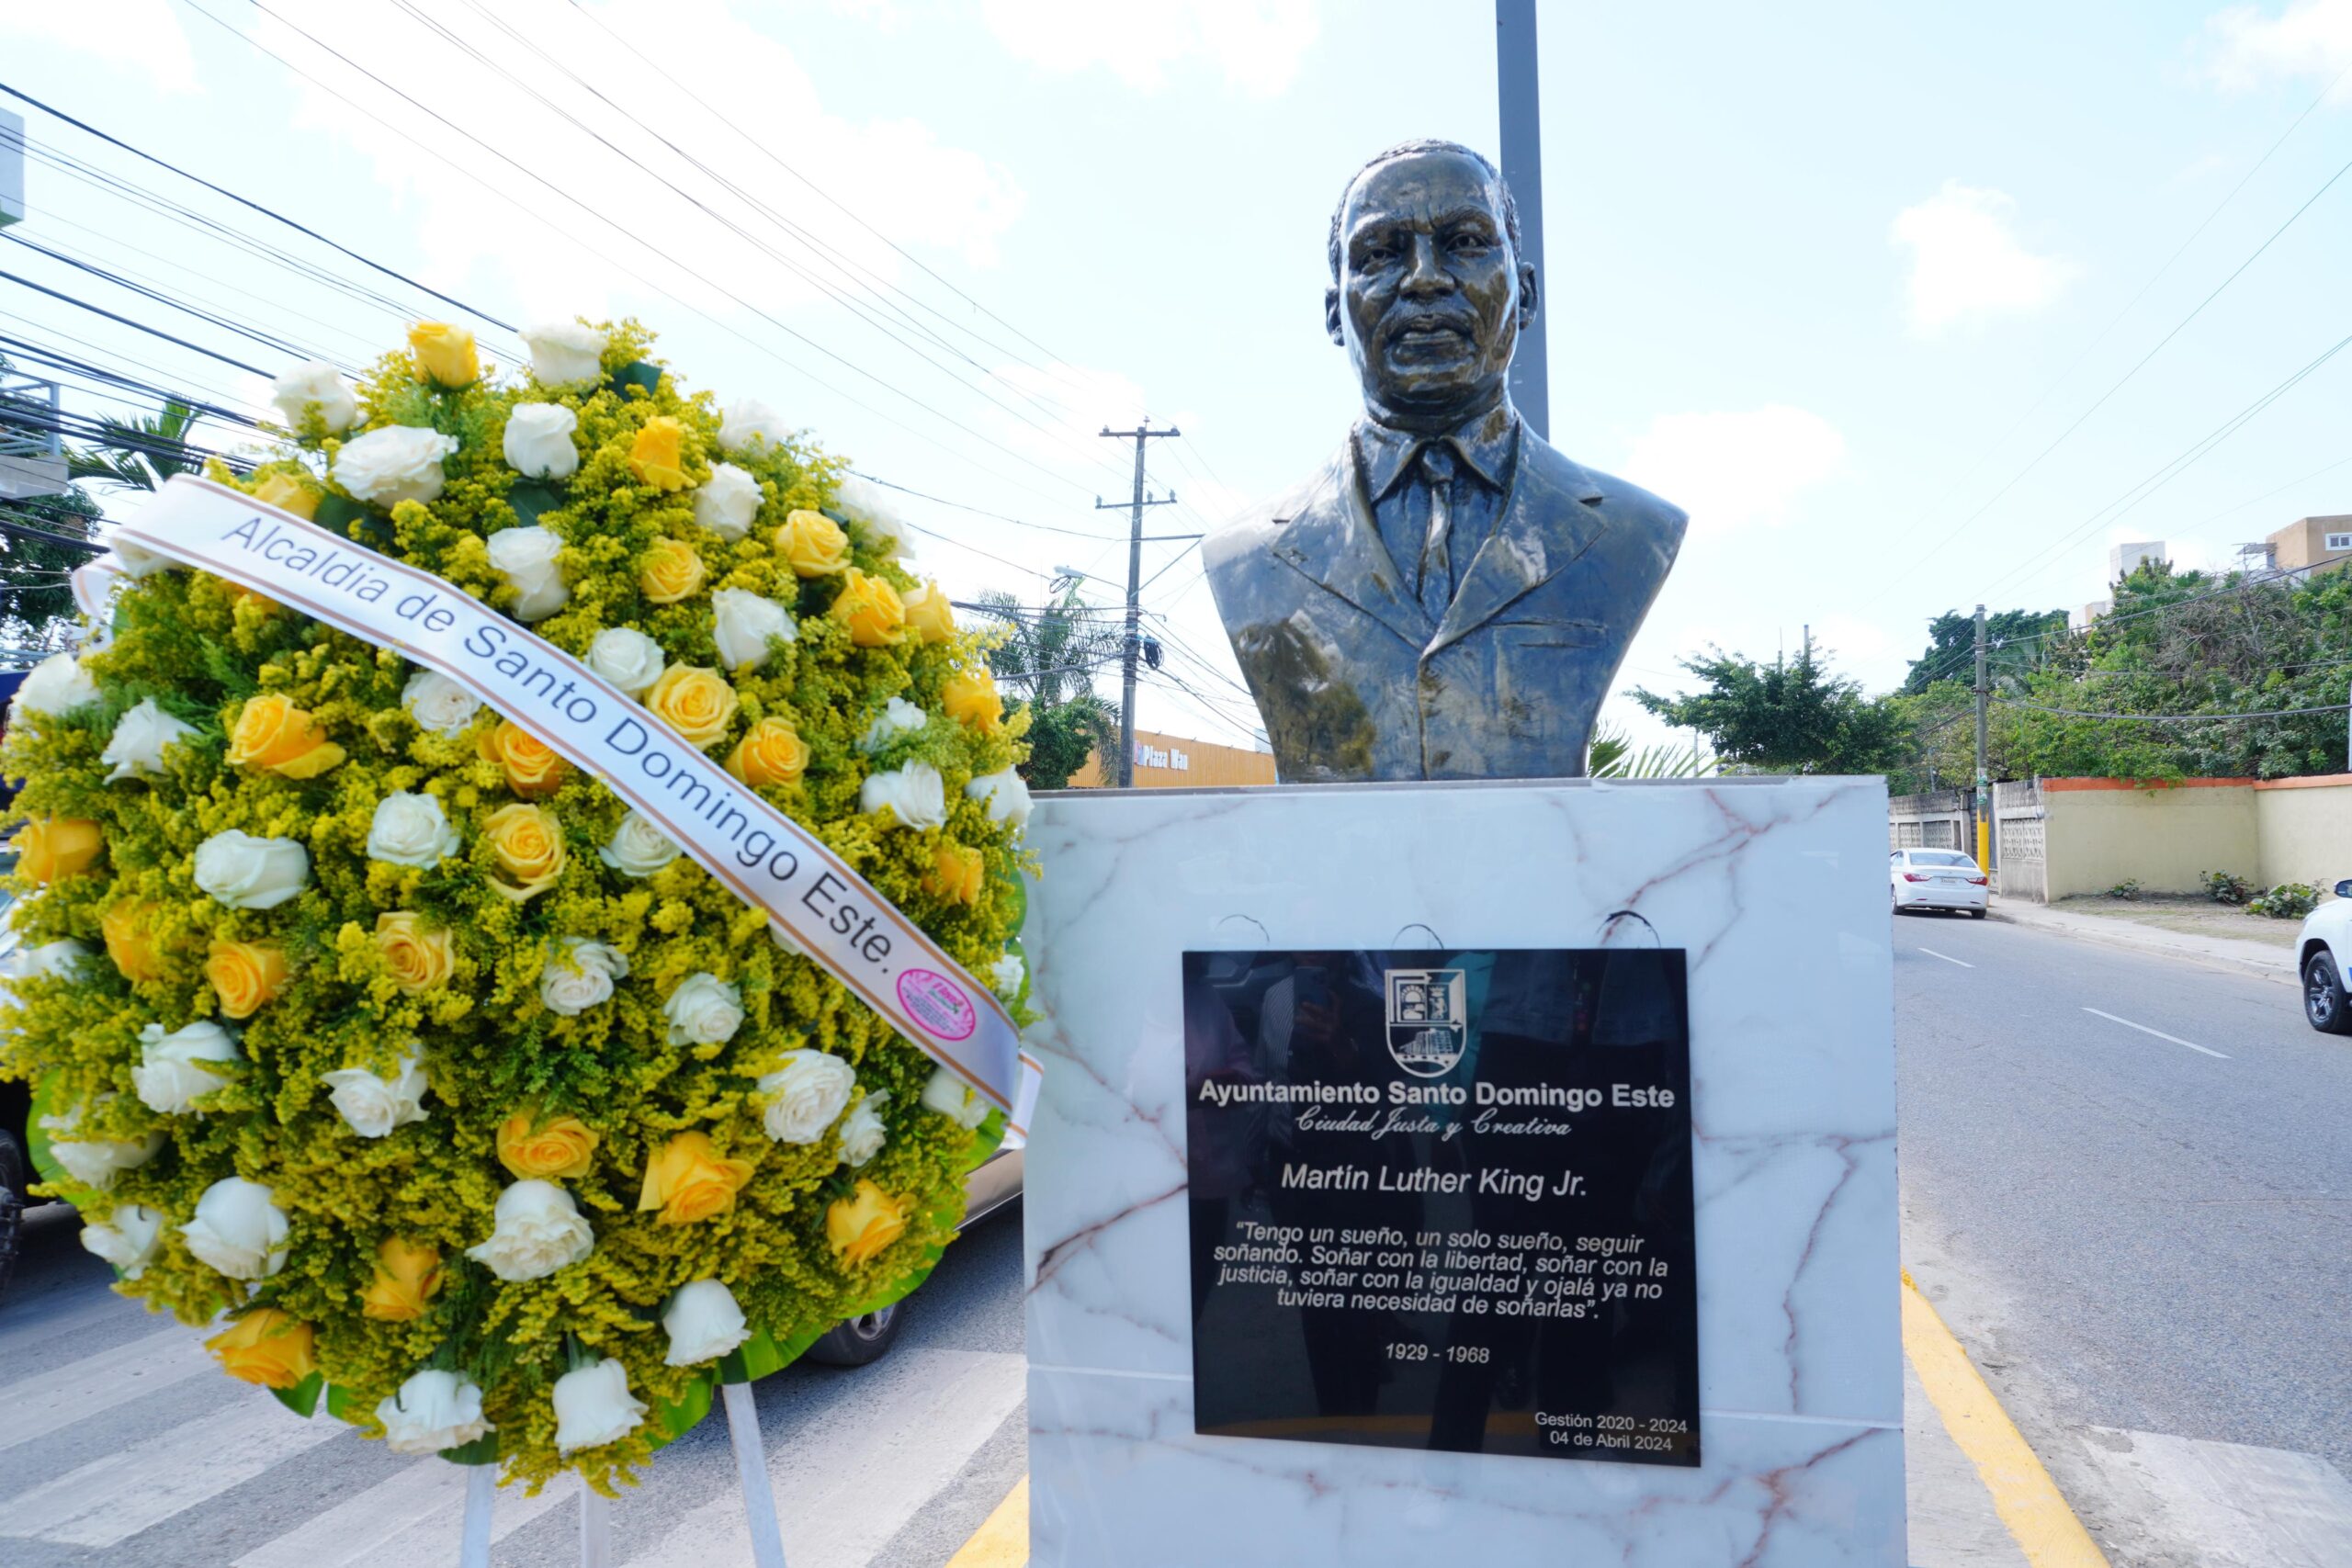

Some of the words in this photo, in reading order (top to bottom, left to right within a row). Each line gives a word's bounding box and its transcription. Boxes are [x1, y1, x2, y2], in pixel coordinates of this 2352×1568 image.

[1143, 745, 1168, 768] Plaza
[397, 593, 456, 632] de
[464, 626, 597, 724] Santo
[604, 717, 799, 882] Domingo
[801, 872, 892, 974] Este.
[1198, 1078, 1380, 1107] Ayuntamiento
[1387, 1080, 1467, 1105] Santo
[1476, 1082, 1603, 1113] Domingo
[1611, 1083, 1675, 1108] Este
[1295, 1105, 1380, 1132] Ciudad
[1371, 1106, 1439, 1140] Justa
[1440, 1122, 1463, 1141] y
[1471, 1108, 1572, 1135] Creativa
[1281, 1163, 1369, 1190] Martín
[1378, 1165, 1472, 1193] Luther
[1478, 1168, 1544, 1202] King
[1553, 1170, 1586, 1196] Jr.
[1309, 1228, 1334, 1243] un
[1340, 1227, 1408, 1247] sueño,
[1415, 1231, 1442, 1247] un
[1447, 1230, 1491, 1248] solo
[1497, 1232, 1567, 1253] sueño,
[1576, 1235, 1645, 1257] seguir
[1214, 1244, 1304, 1263] soñando.
[1311, 1246, 1373, 1267] Soñar
[1376, 1251, 1414, 1267] con
[1419, 1249, 1439, 1269] la
[1444, 1250, 1528, 1274] libertad,
[1534, 1255, 1598, 1274] soñar
[1602, 1258, 1643, 1276] con
[1648, 1258, 1668, 1277] la
[1217, 1264, 1294, 1287] justicia,
[1300, 1268, 1358, 1287] soñar
[1363, 1272, 1399, 1289] con
[1405, 1270, 1424, 1290] la
[1430, 1271, 1521, 1295] igualdad
[1524, 1280, 1539, 1299] y
[1544, 1277, 1595, 1301] ojalá
[1600, 1283, 1628, 1302] ya
[1634, 1283, 1663, 1300] no
[1277, 1288, 1345, 1309] tuviera
[1351, 1292, 1456, 1314] necesidad
[1462, 1295, 1488, 1314] de
[1385, 1342, 1429, 1361] 1929
[1446, 1346, 1490, 1364] 1968
[1534, 1411, 1592, 1428] Gestión
[1596, 1415, 1634, 1431] 2020
[1649, 1418, 1688, 1434] 2024
[1549, 1430, 1569, 1445] 04
[1573, 1432, 1593, 1447] de
[1595, 1433, 1631, 1449] Abril
[1634, 1435, 1673, 1451] 2024
